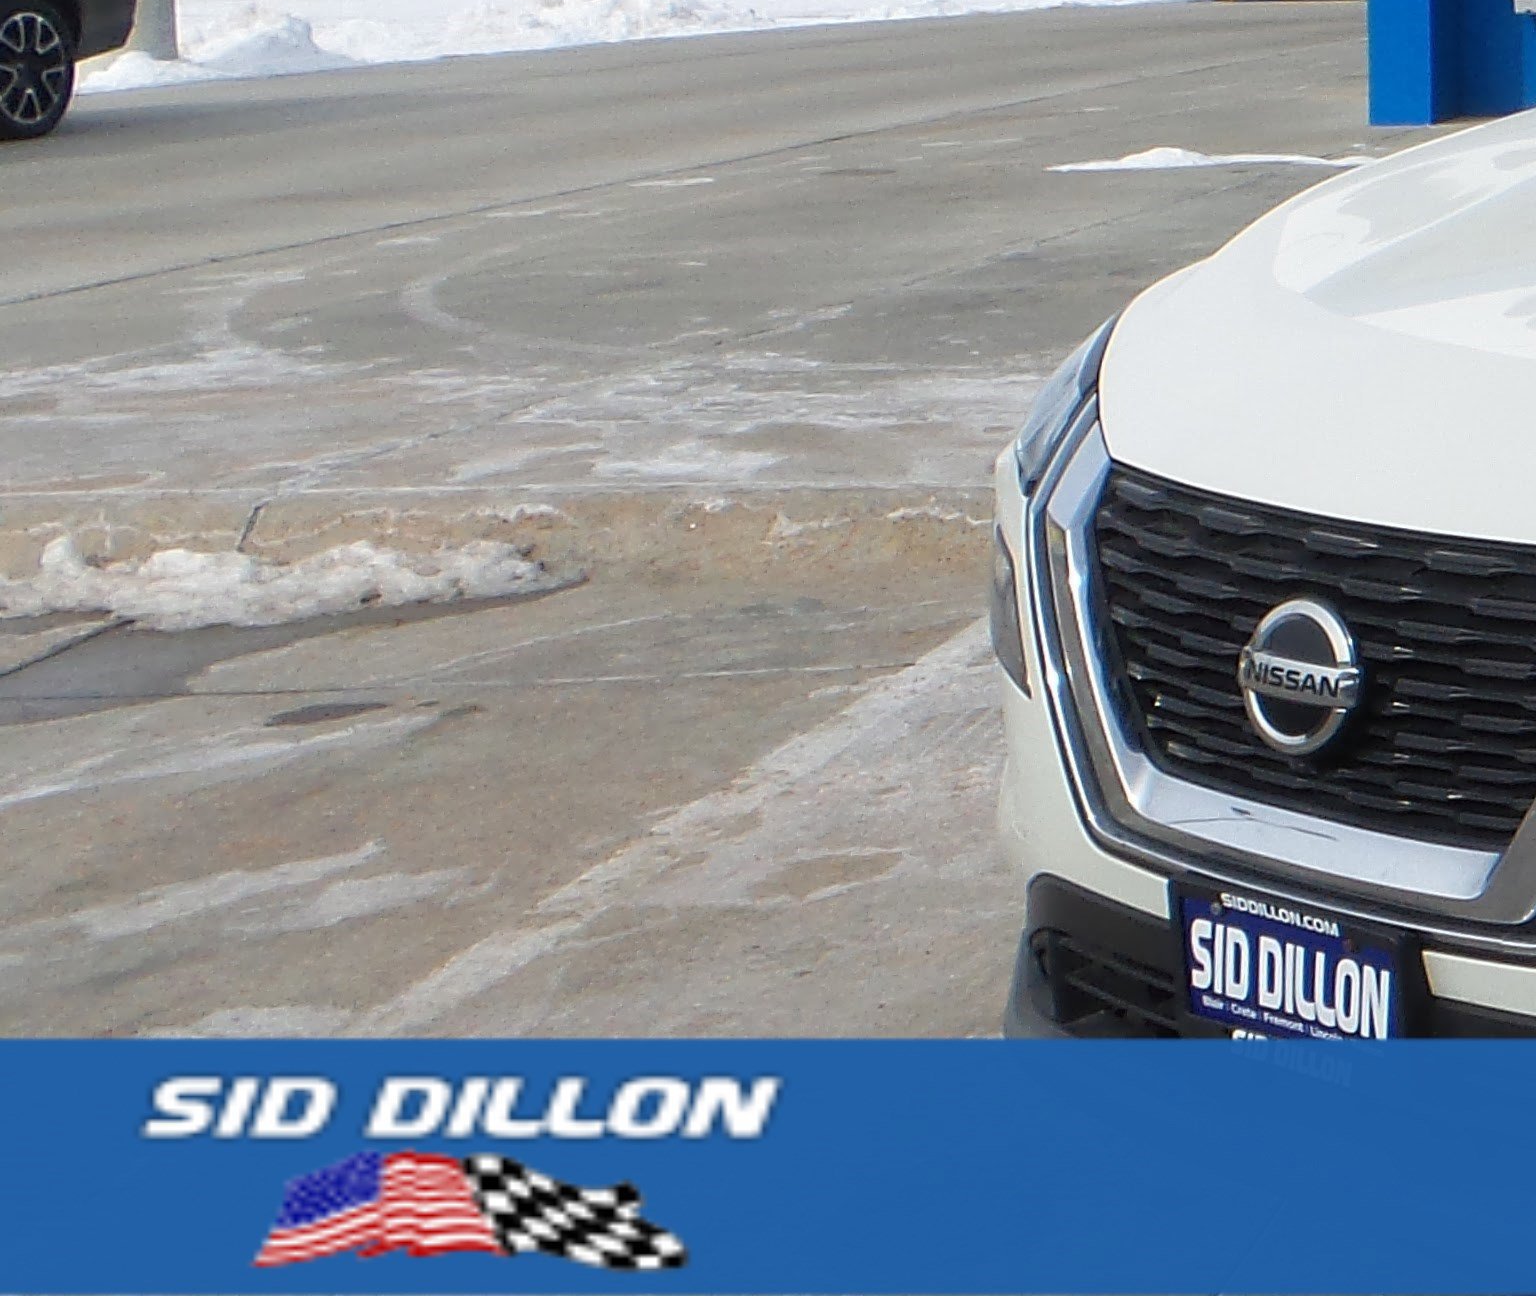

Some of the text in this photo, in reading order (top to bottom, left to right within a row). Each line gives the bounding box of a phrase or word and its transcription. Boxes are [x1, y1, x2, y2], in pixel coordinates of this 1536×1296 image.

[1246, 660, 1341, 698] NISSAN
[1220, 892, 1340, 938] SIDDILLON.COM
[1190, 917, 1391, 1041] SID DILLON
